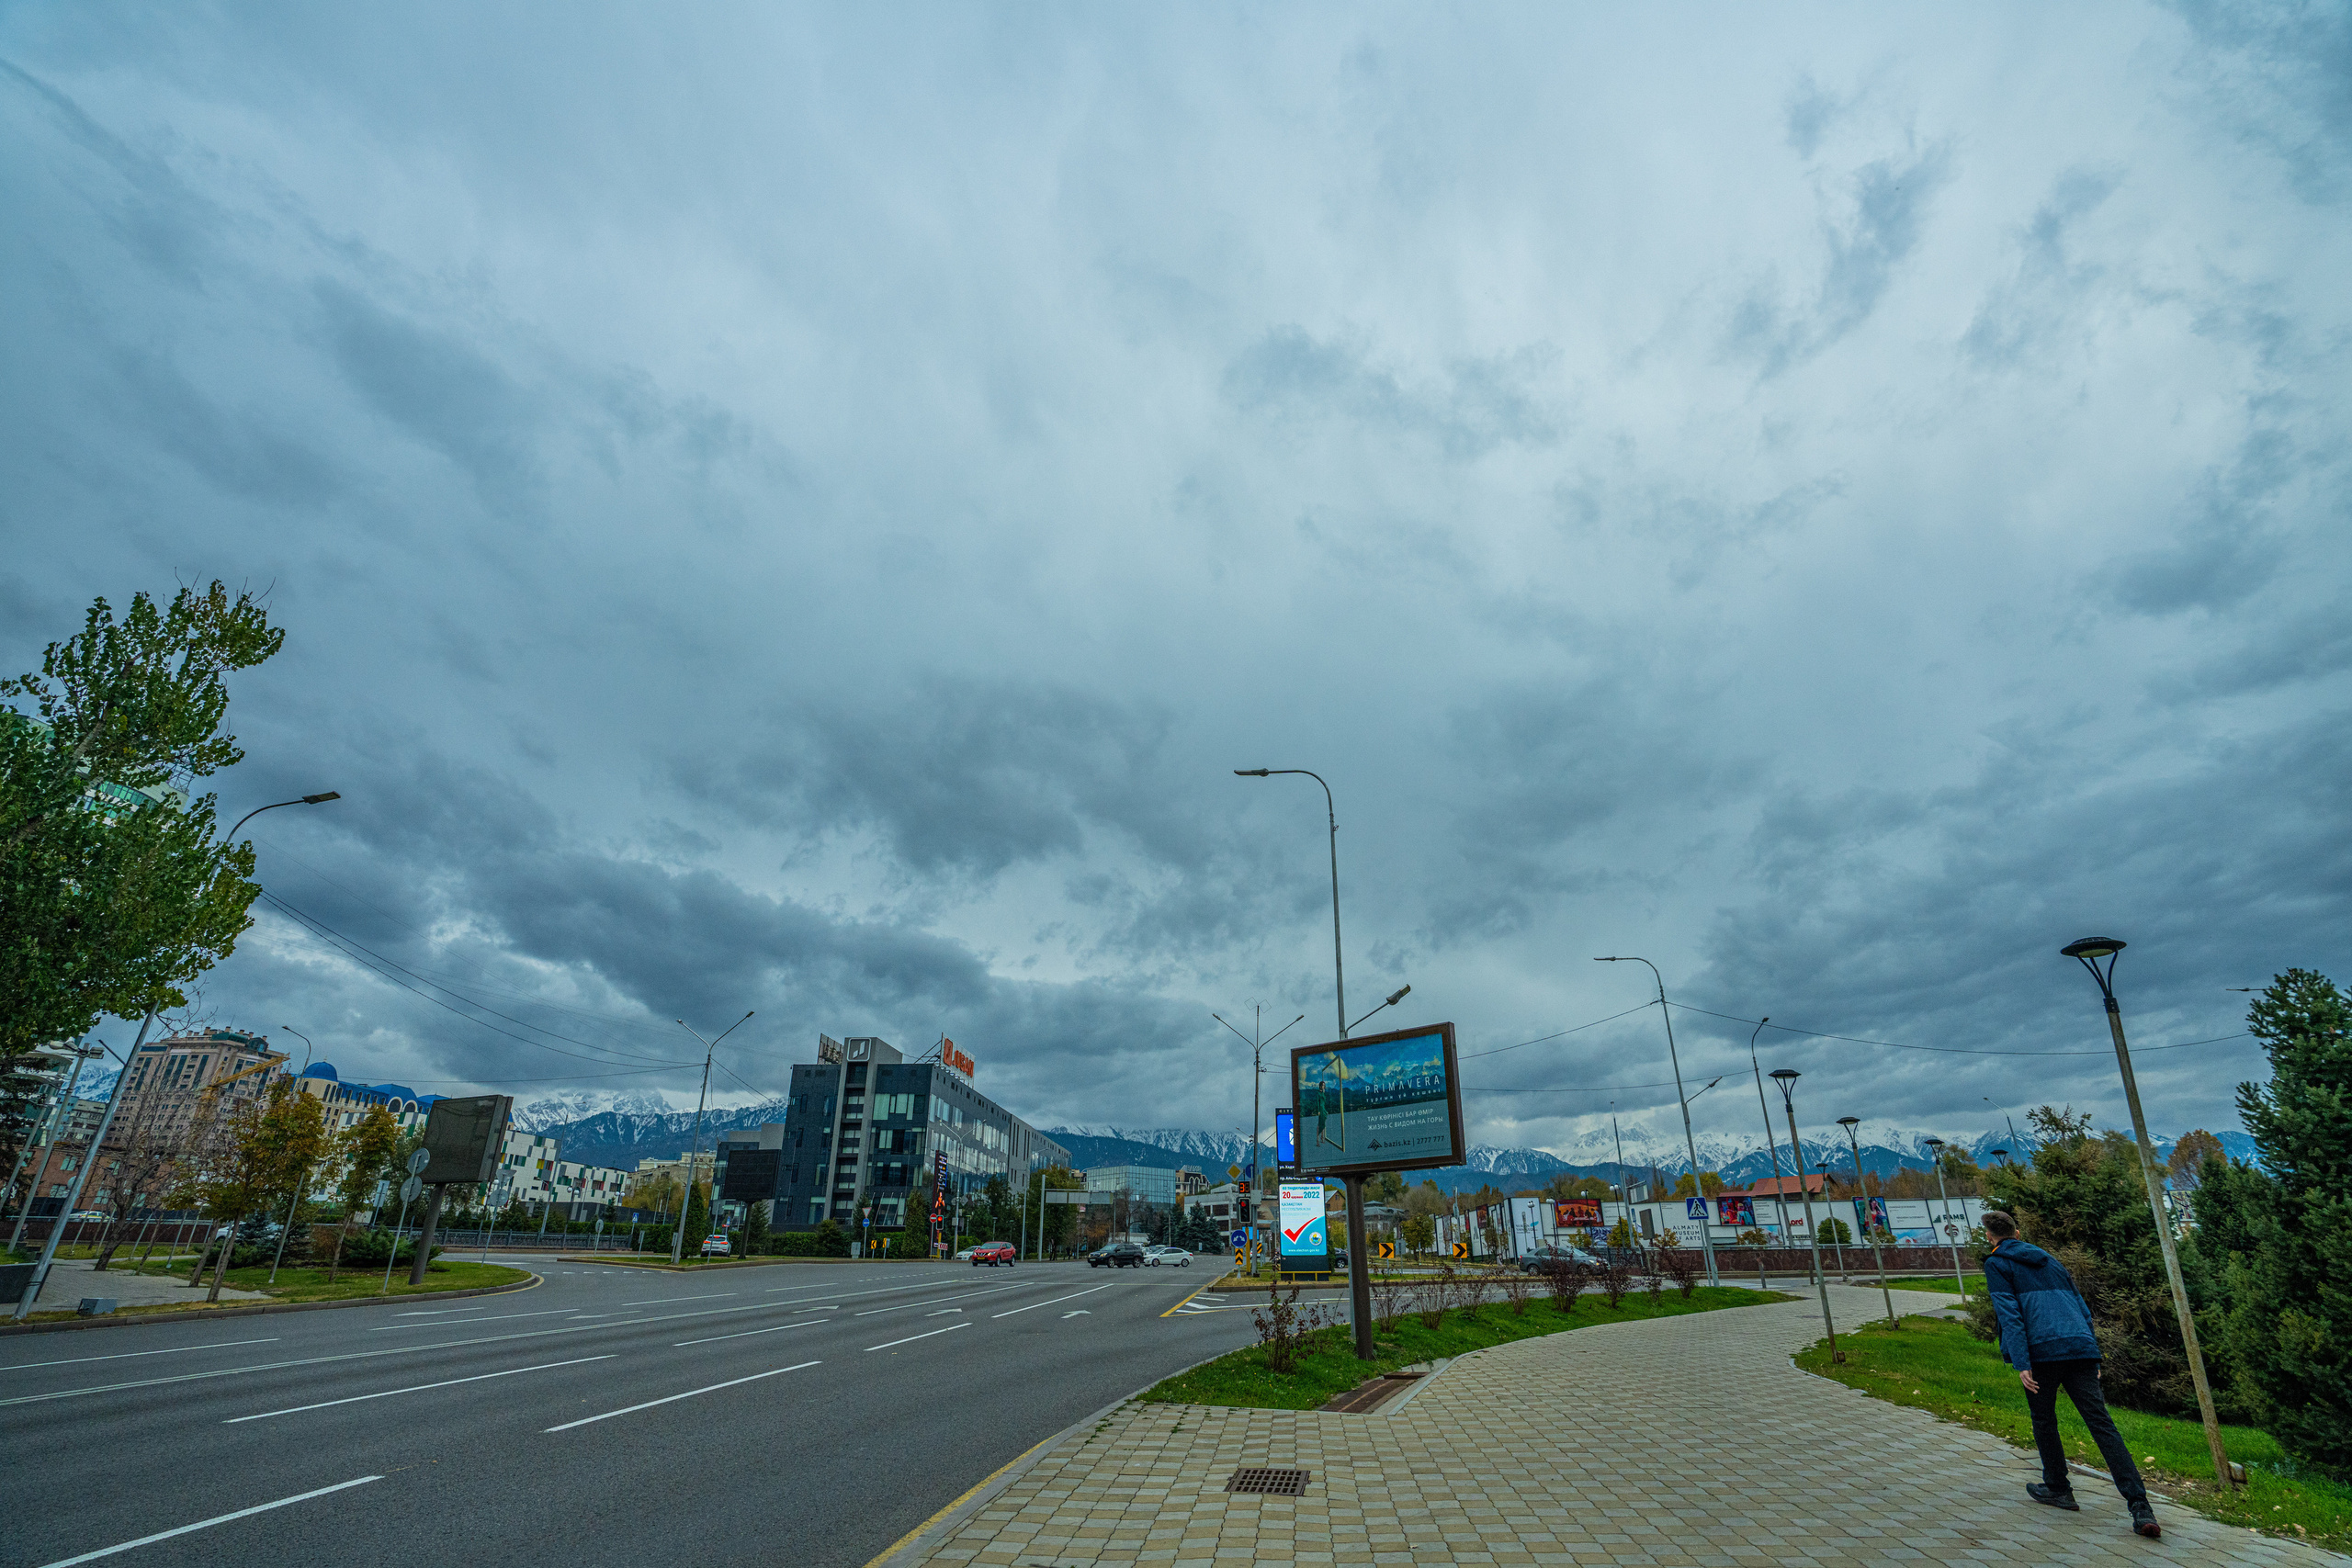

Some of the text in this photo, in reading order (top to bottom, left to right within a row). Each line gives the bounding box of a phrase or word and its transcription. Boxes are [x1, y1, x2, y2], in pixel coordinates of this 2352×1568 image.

[1365, 1075, 1440, 1094] PRIMAVERA
[1395, 1119, 1416, 1128] ВИДОМ
[1384, 1139, 1410, 1148] bazis.kz
[1417, 1136, 1431, 1145] 2777
[1282, 1190, 1291, 1199] 20
[1303, 1190, 1319, 1199] 2022
[1789, 1217, 1804, 1225] ord
